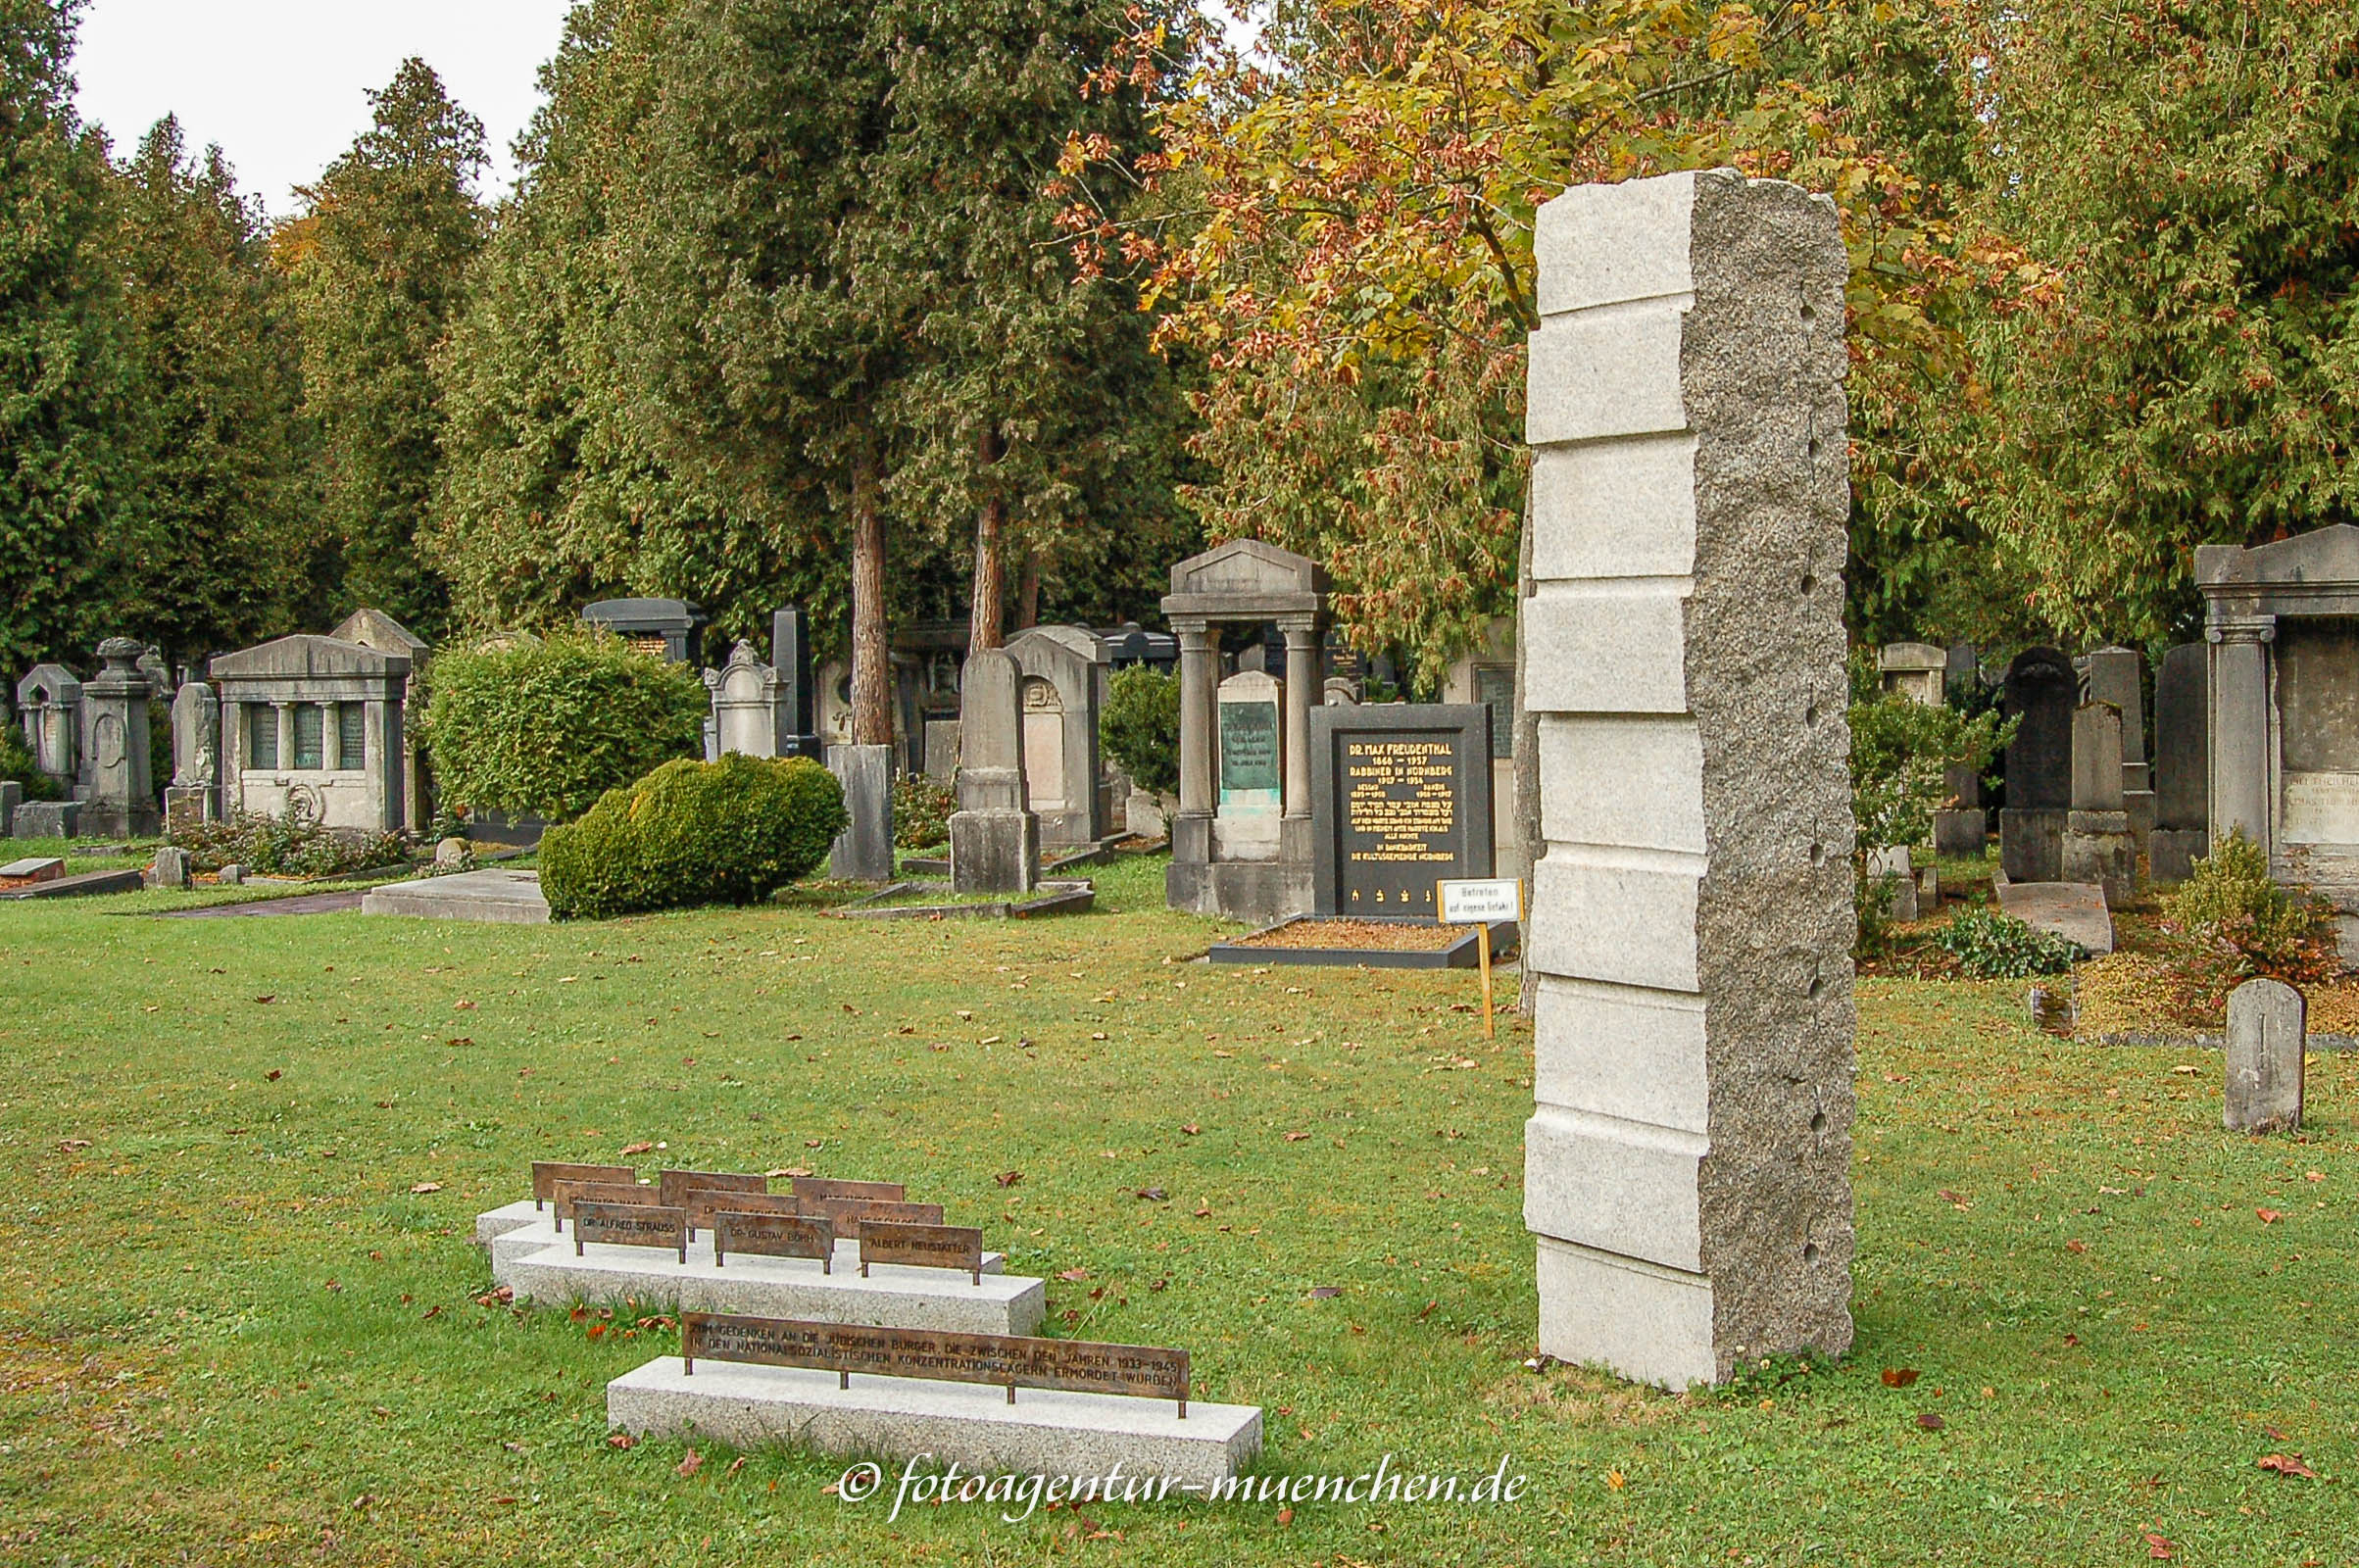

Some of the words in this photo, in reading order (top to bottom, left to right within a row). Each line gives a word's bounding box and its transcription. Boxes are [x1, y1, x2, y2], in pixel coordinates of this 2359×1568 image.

[1364, 744, 1385, 756] MAX
[1387, 743, 1452, 756] FREUDENTHAL
[1406, 756, 1428, 765] 1937
[1350, 765, 1392, 776] RABBINER
[600, 1219, 632, 1231] ALFRED
[636, 1221, 676, 1233] STRAUSS
[748, 1230, 783, 1241] GUSTAV
[870, 1238, 907, 1250] ALBERT
[691, 1324, 713, 1335] ZUM
[720, 1325, 774, 1341] GEDENKEN
[781, 1332, 796, 1342] AN
[802, 1332, 819, 1344] DIE
[945, 1342, 962, 1355] DIE
[969, 1344, 1027, 1360] ZWISCHEN
[1033, 1349, 1057, 1362] DEN
[1065, 1352, 1110, 1368] JAHREN
[691, 1337, 703, 1348] IN
[708, 1338, 730, 1350] DEN
[736, 1340, 891, 1363] NATIONALSOZIALISTISCHEN
[897, 1354, 1048, 1378] KONZENTRATIONSLAGERN
[1054, 1366, 1118, 1383] ERMORDET
[1126, 1372, 1178, 1388] WURDEN
